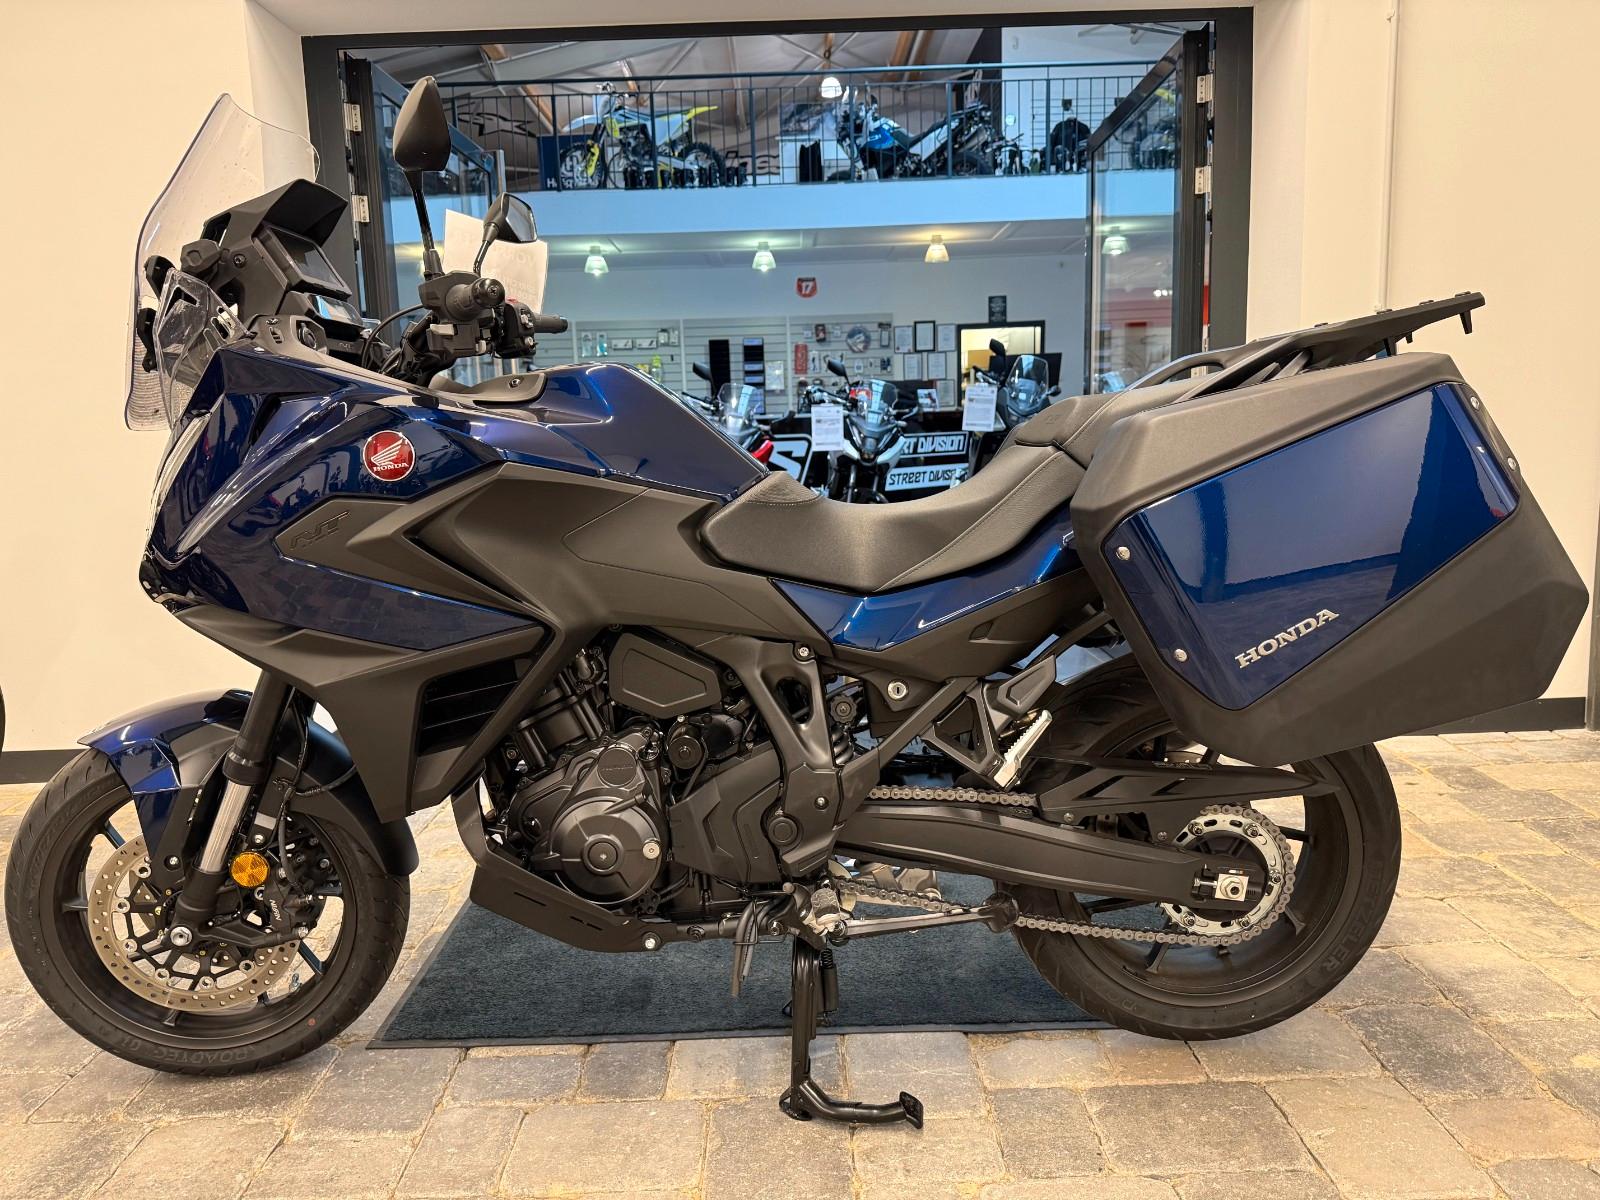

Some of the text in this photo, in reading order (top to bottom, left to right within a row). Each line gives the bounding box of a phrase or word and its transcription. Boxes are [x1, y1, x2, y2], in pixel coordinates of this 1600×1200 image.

[801, 281, 813, 294] 17
[373, 463, 410, 472] HONDA
[1234, 609, 1340, 669] HONDA
[152, 1048, 249, 1064] ROADTEC
